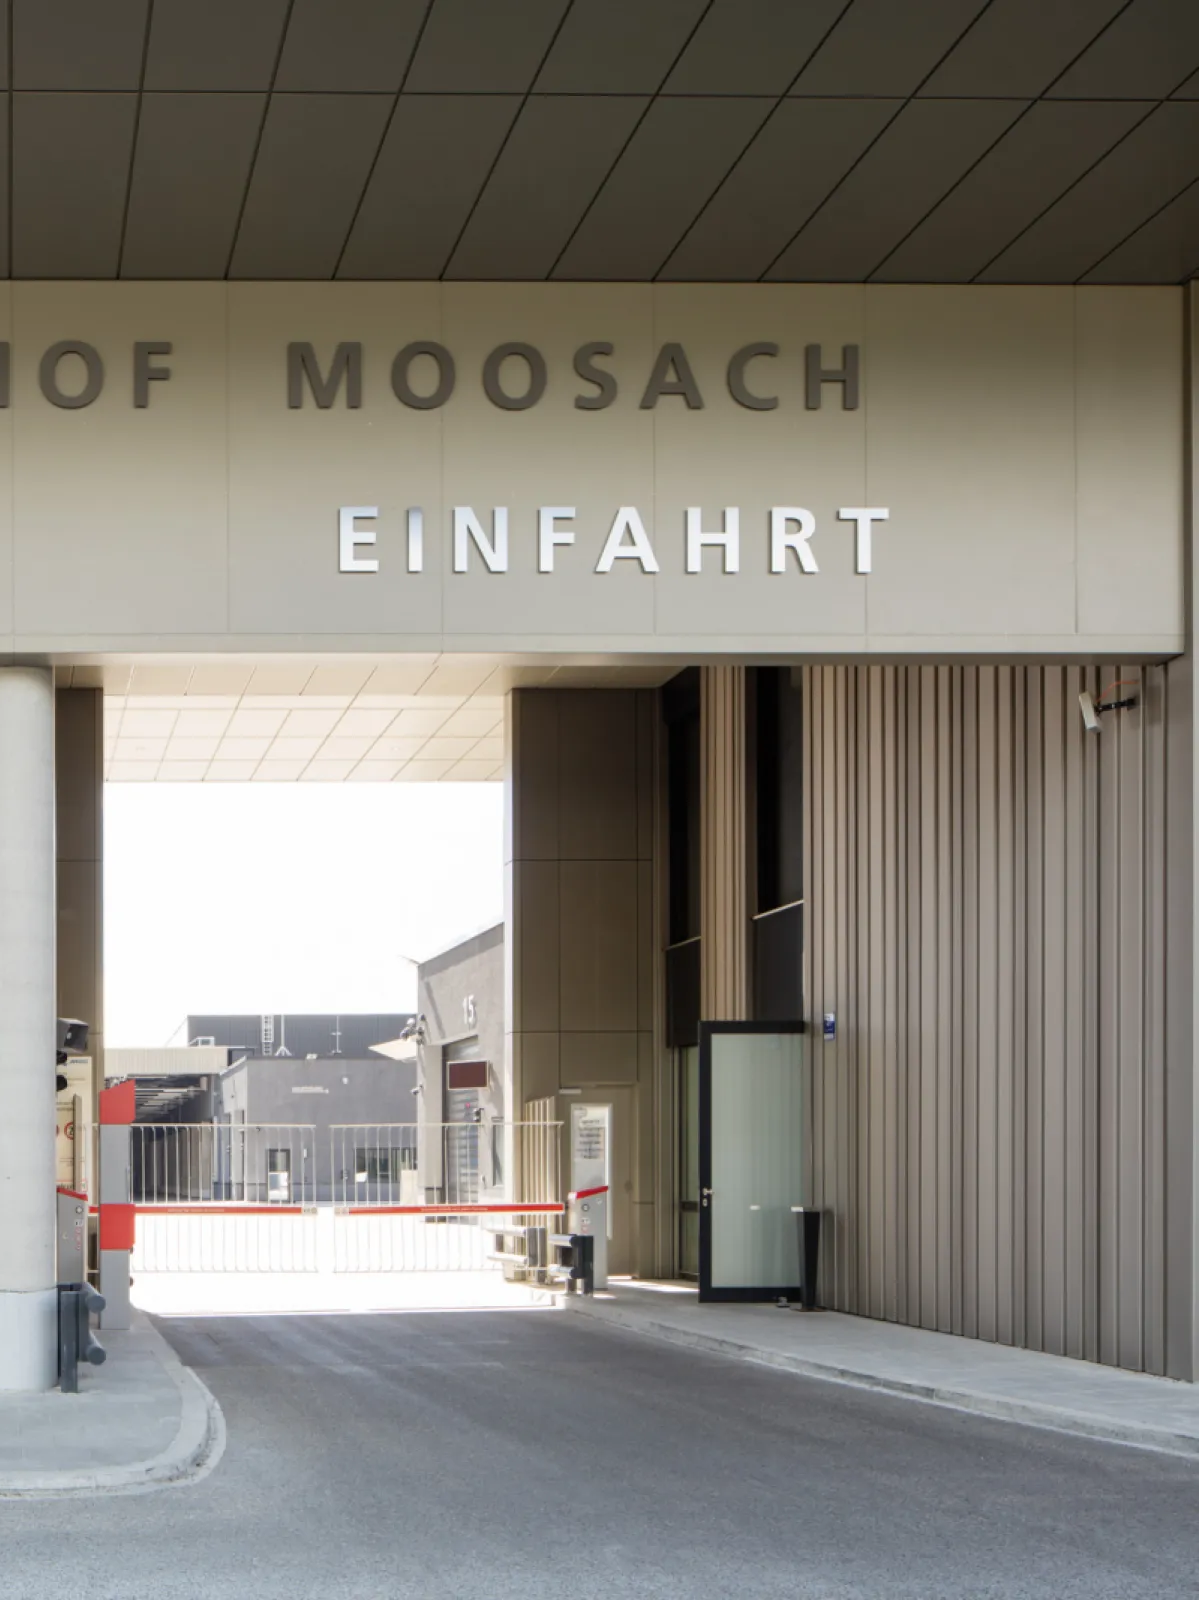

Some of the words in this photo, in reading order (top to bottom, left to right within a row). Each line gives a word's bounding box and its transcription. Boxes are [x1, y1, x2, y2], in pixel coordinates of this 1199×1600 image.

[286, 341, 860, 411] MOOSACH
[338, 506, 890, 574] EINFAHRT
[462, 994, 476, 1026] 15
